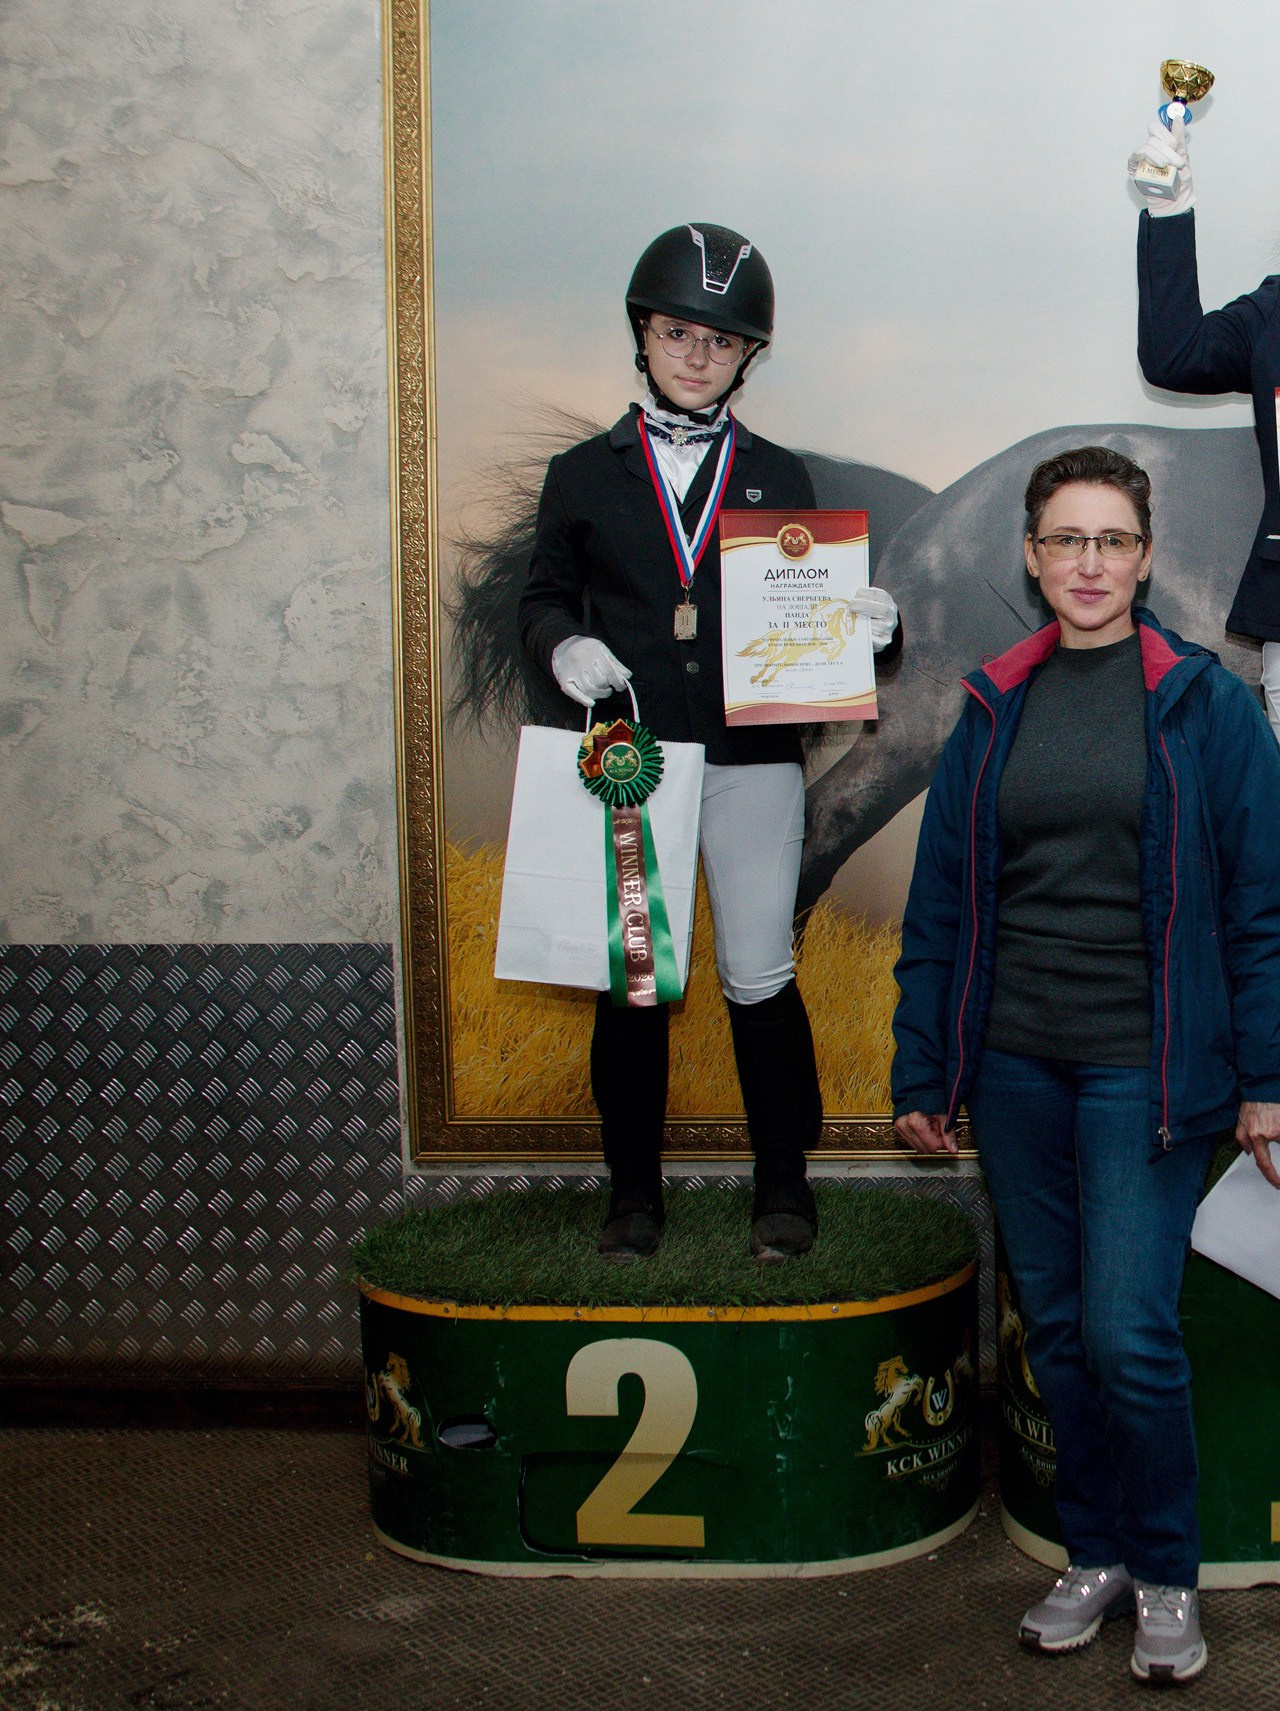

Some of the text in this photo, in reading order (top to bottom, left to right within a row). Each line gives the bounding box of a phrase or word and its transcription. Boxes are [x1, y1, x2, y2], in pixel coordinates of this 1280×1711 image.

[764, 568, 828, 581] ДИПЛОМ
[620, 830, 648, 962] WINNER CLUB
[628, 972, 655, 983] 2026
[566, 1337, 705, 1548] 2
